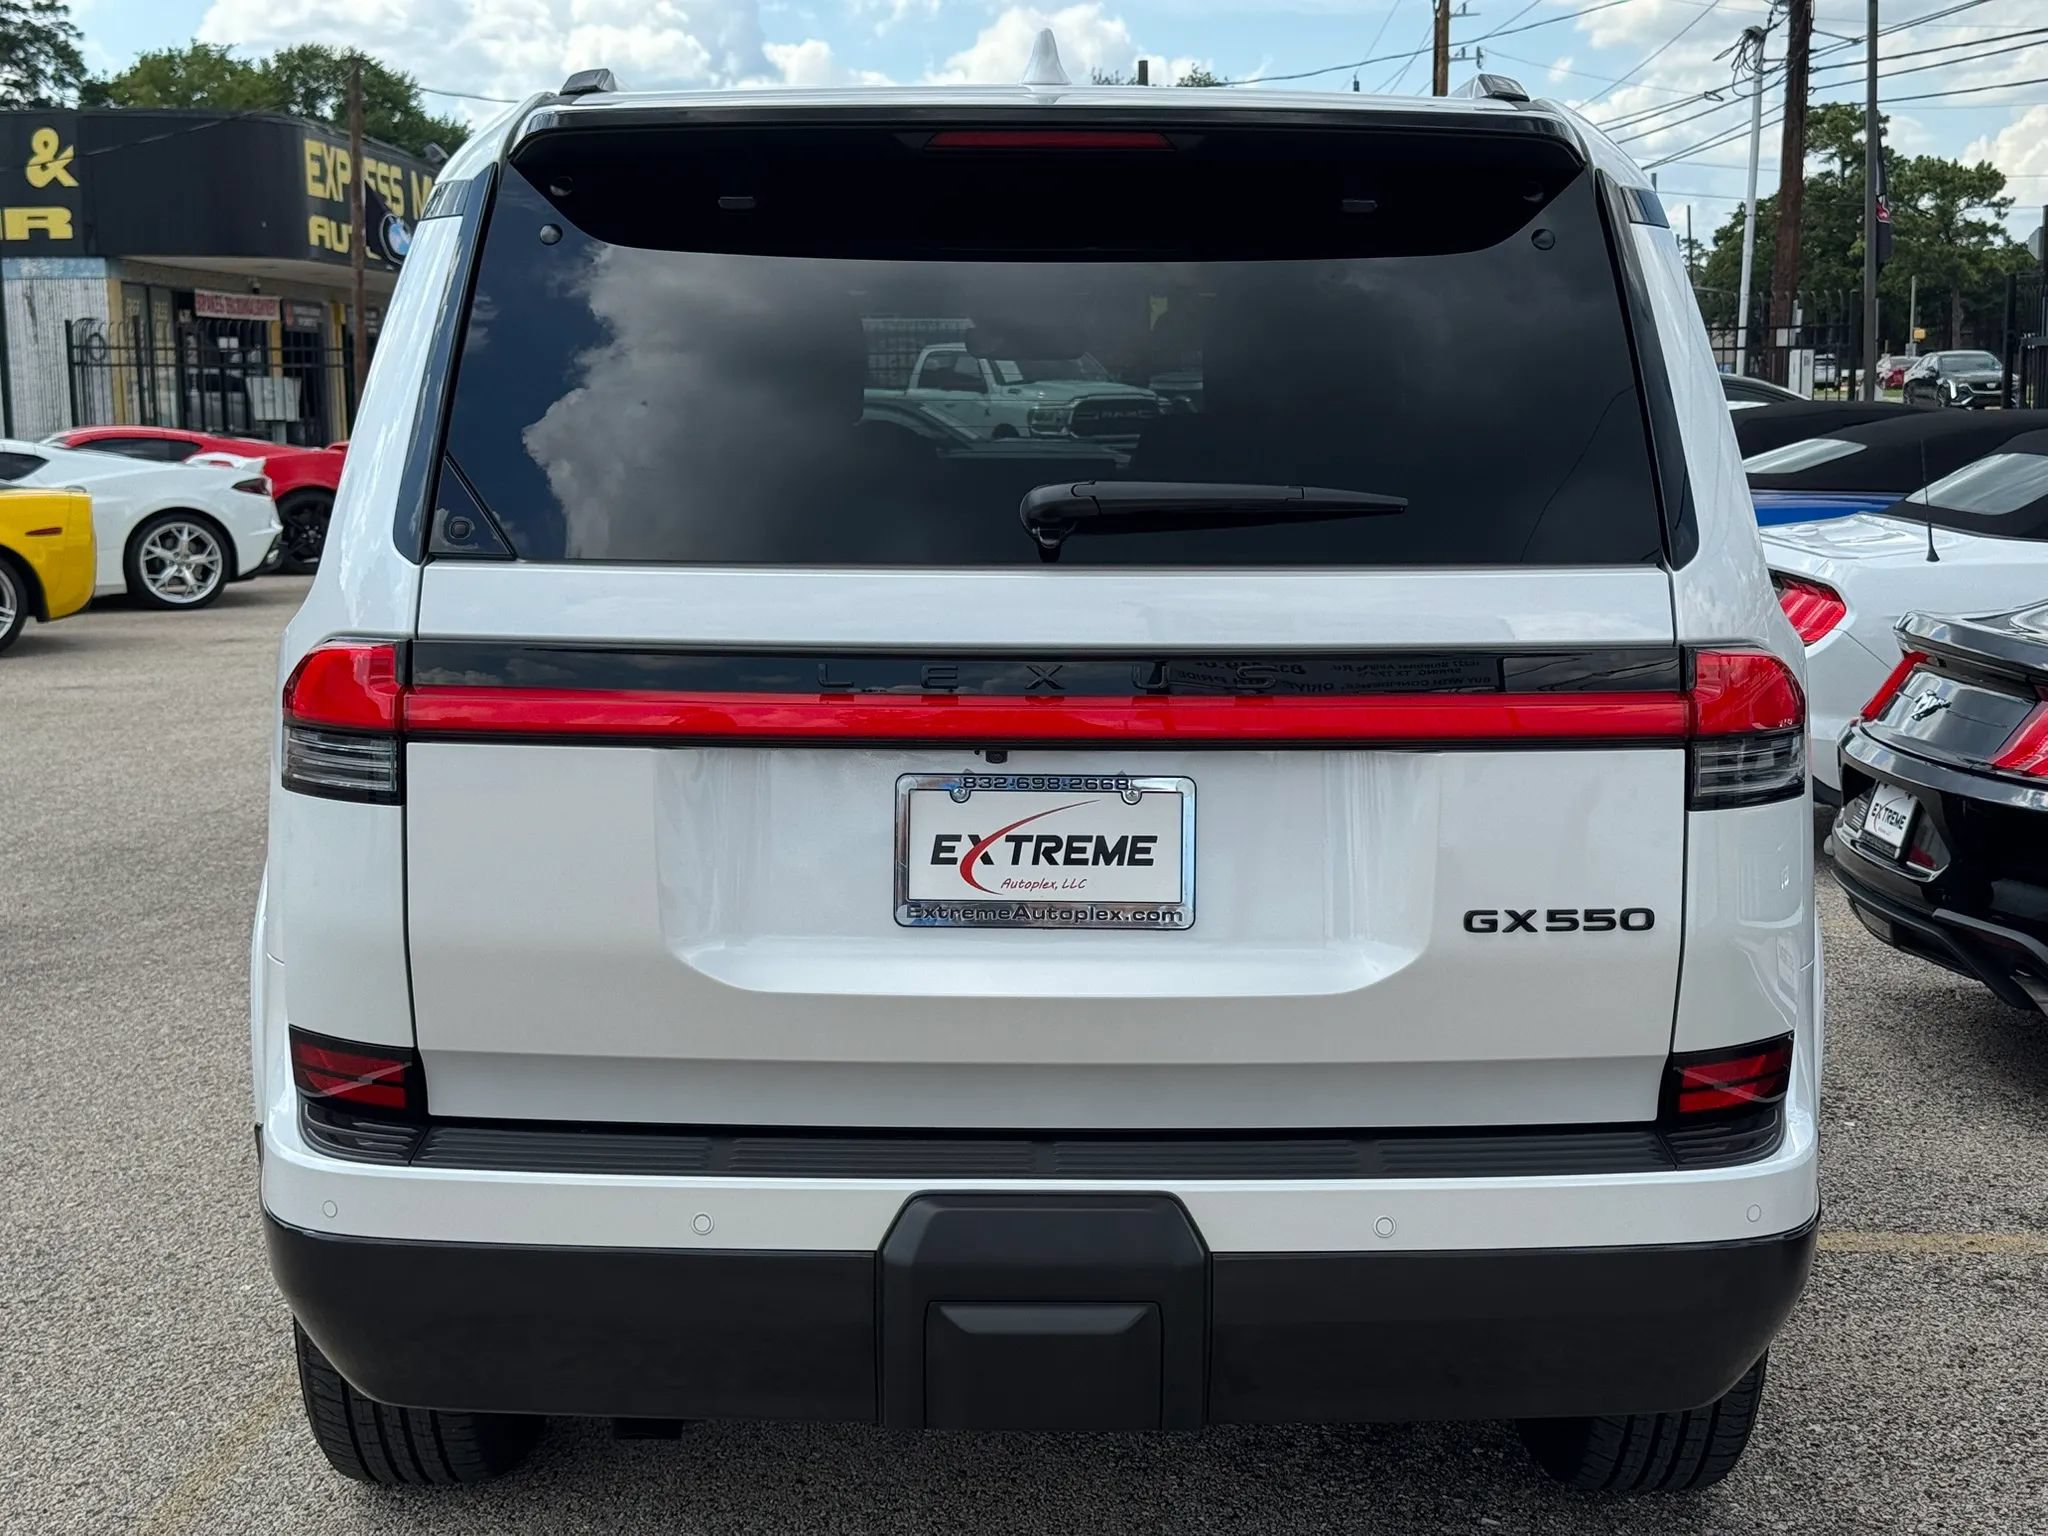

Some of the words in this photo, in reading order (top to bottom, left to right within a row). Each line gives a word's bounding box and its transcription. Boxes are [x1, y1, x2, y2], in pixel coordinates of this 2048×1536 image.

[26, 127, 79, 188] &
[304, 138, 405, 217] EXPESS
[0, 206, 74, 241] R
[817, 662, 1277, 691] LEXUS
[962, 776, 1130, 791] 832-698-2668
[930, 833, 1159, 867] EXTREME
[1000, 877, 1059, 892] Autoplex,
[1062, 878, 1088, 890] LLC
[906, 903, 1184, 924] ExtremeAutoplex.com
